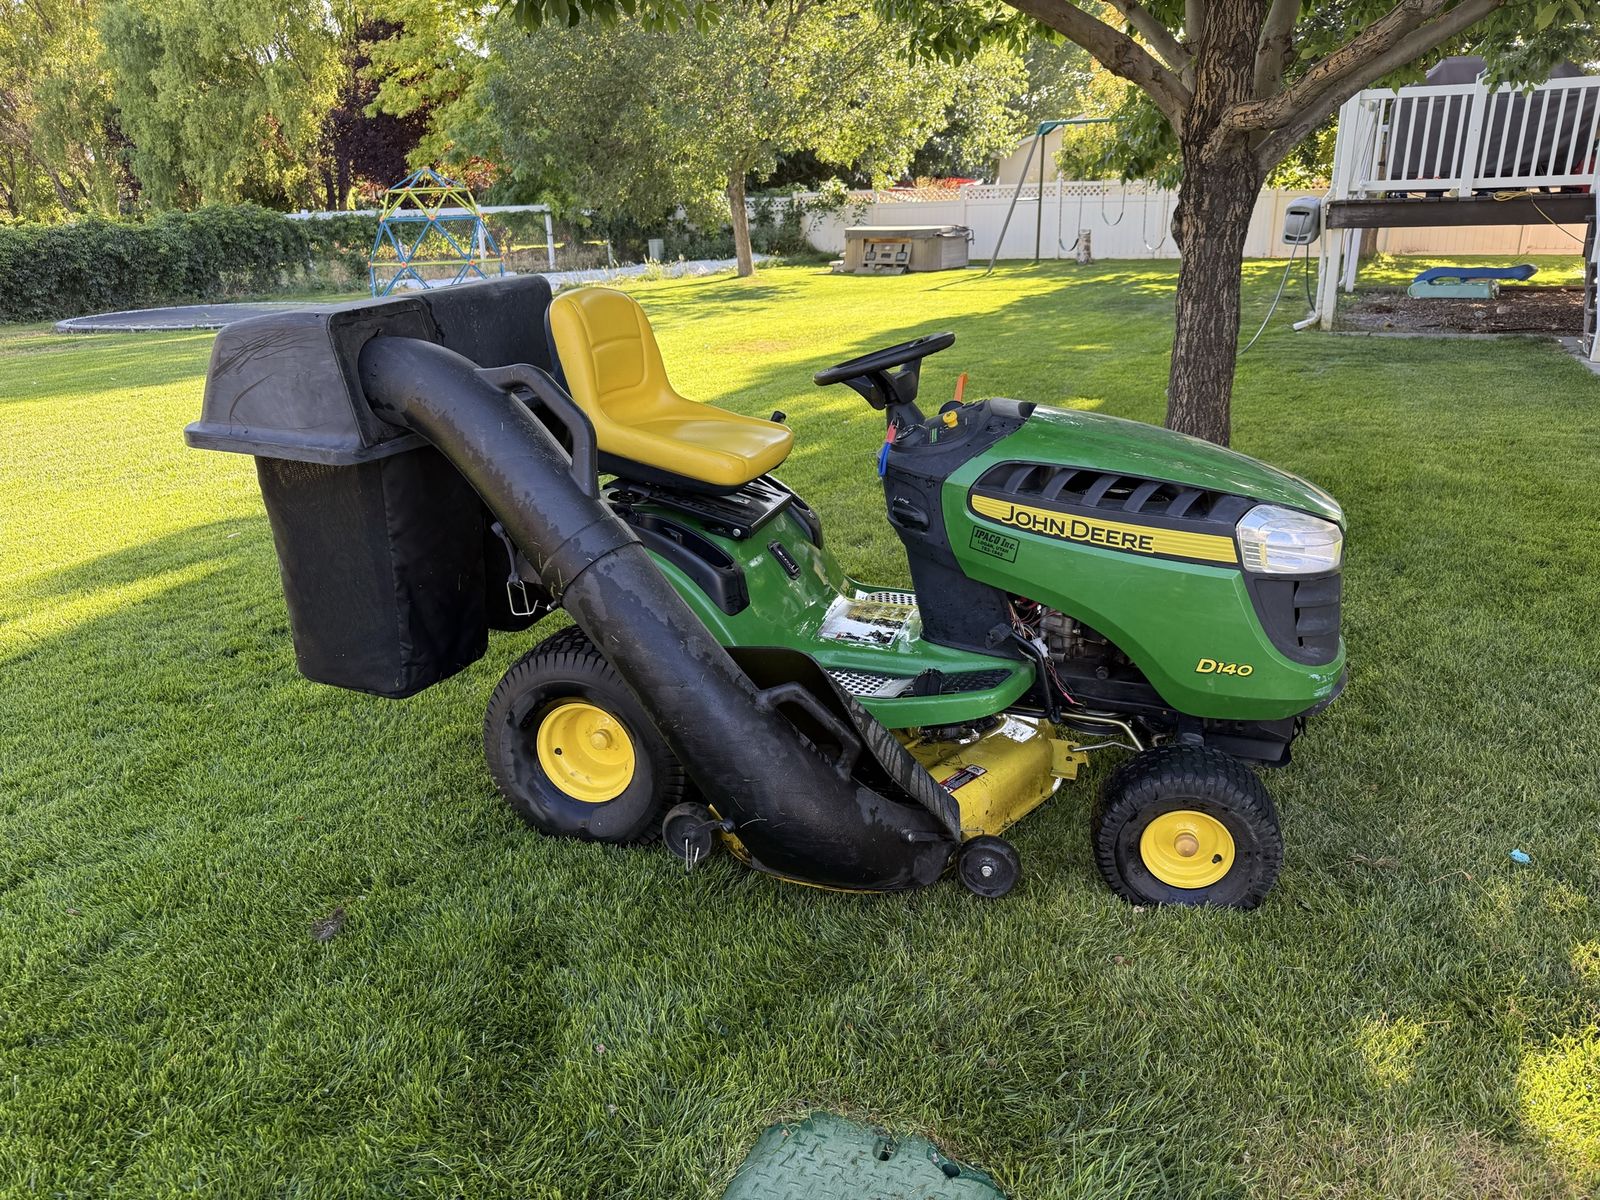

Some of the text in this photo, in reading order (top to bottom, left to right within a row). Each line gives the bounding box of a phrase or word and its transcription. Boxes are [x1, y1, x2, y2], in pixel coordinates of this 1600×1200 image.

[1002, 506, 1154, 551] JOHN DEERE
[974, 529, 1016, 551] IPACO Inc.
[1194, 658, 1254, 677] D140
